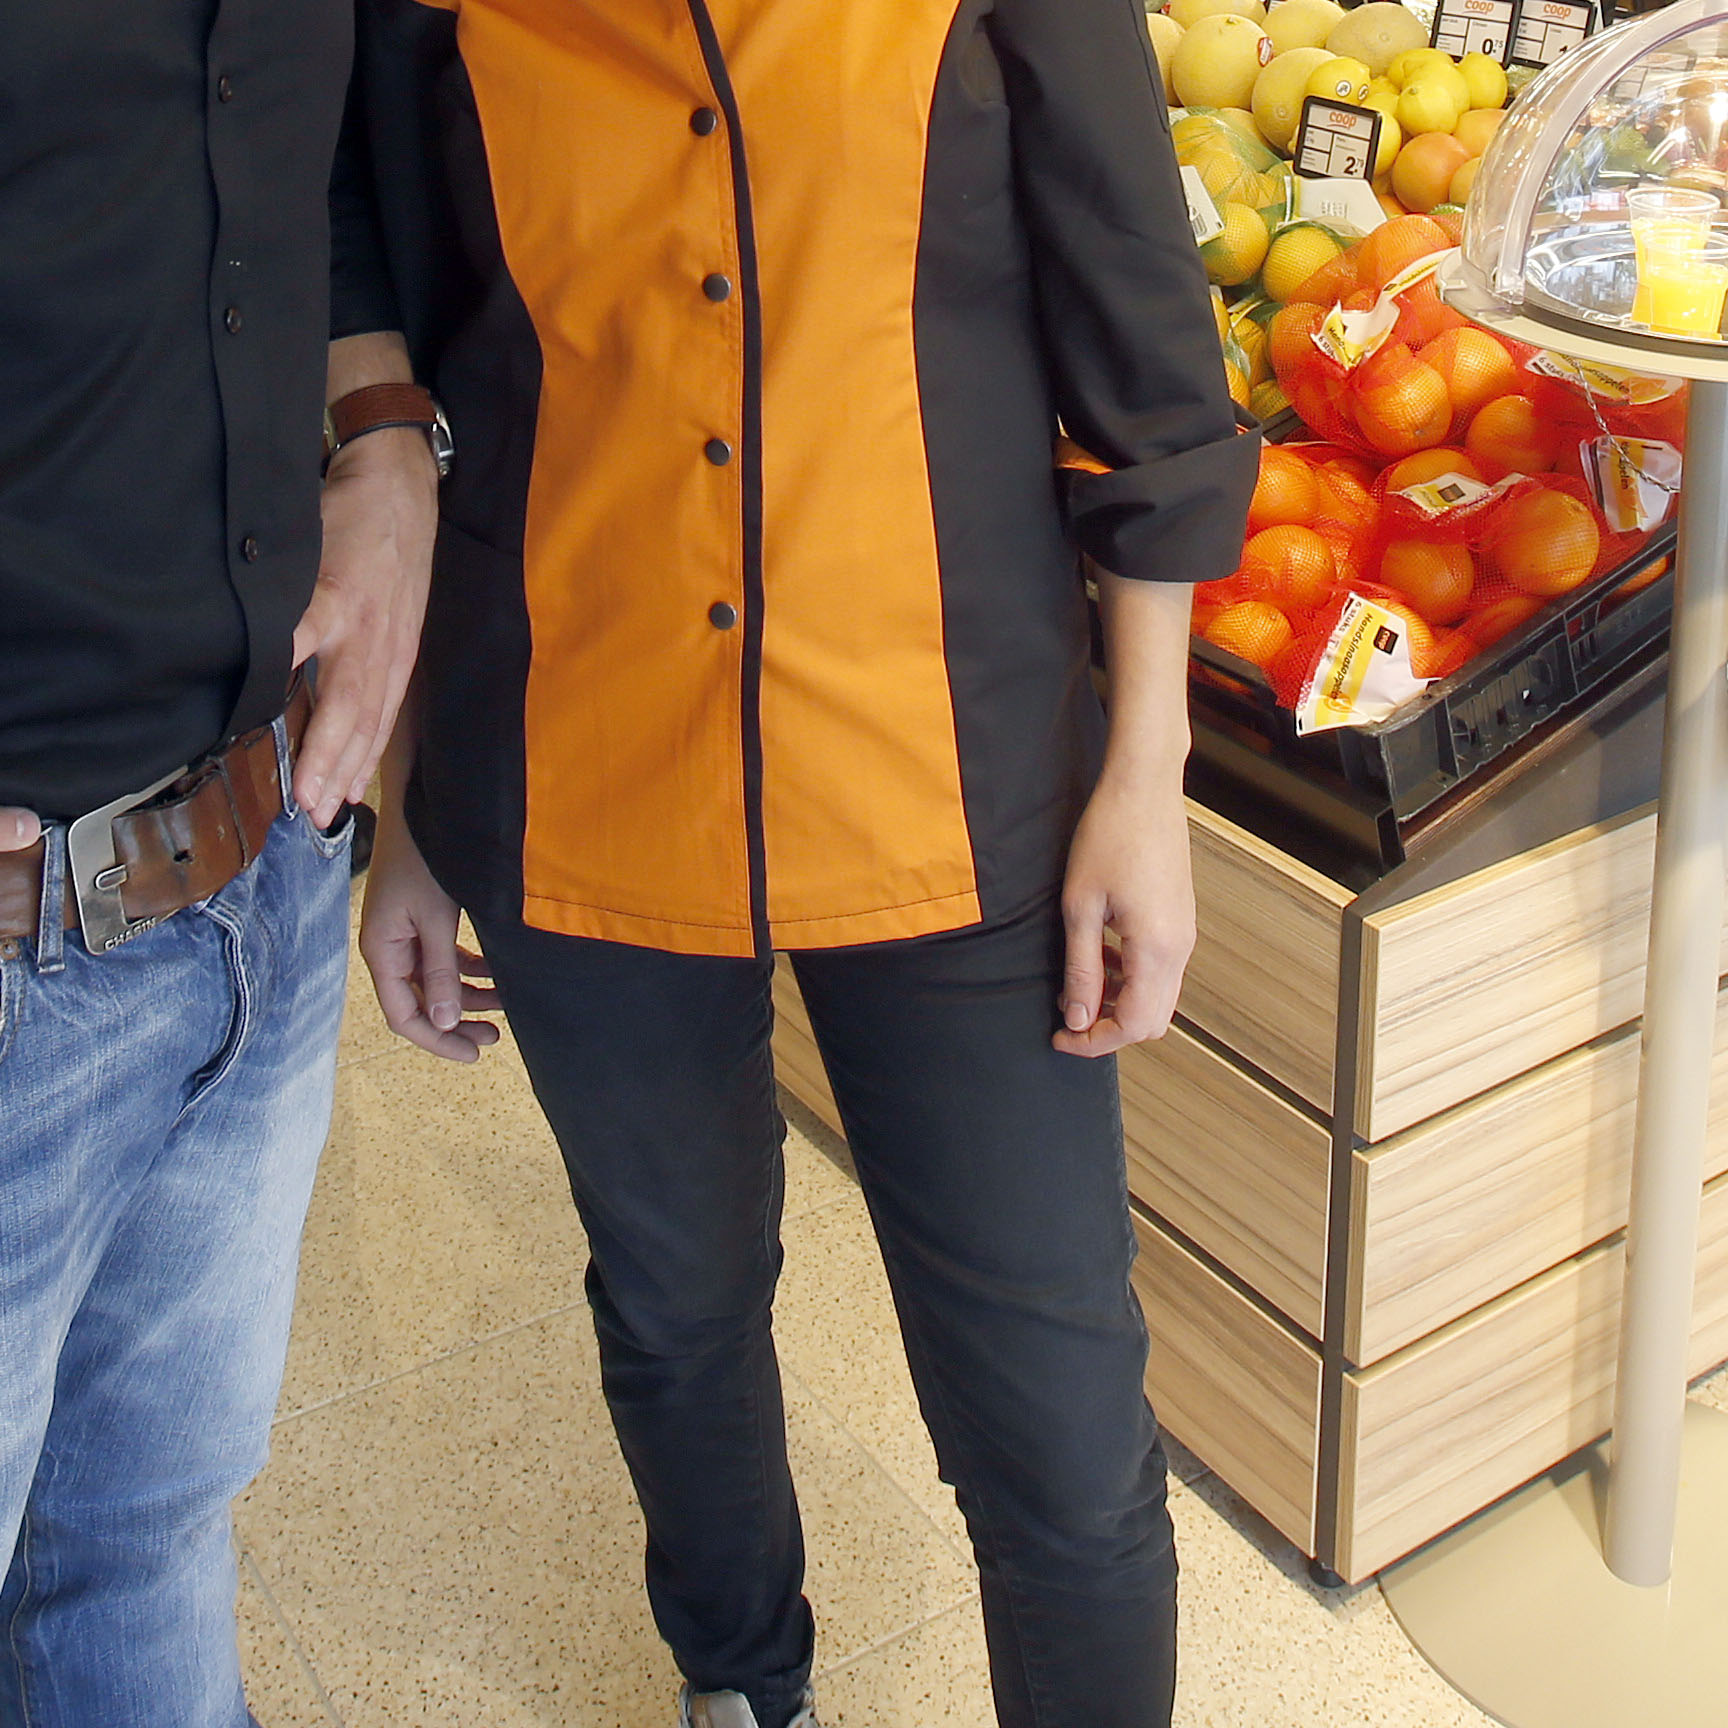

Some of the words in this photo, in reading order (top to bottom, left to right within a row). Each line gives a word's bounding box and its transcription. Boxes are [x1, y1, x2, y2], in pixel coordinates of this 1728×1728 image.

[1464, 0, 1495, 15] coop
[1543, 3, 1572, 20] coop
[1329, 111, 1358, 130] coop
[1338, 609, 1358, 633] stuks
